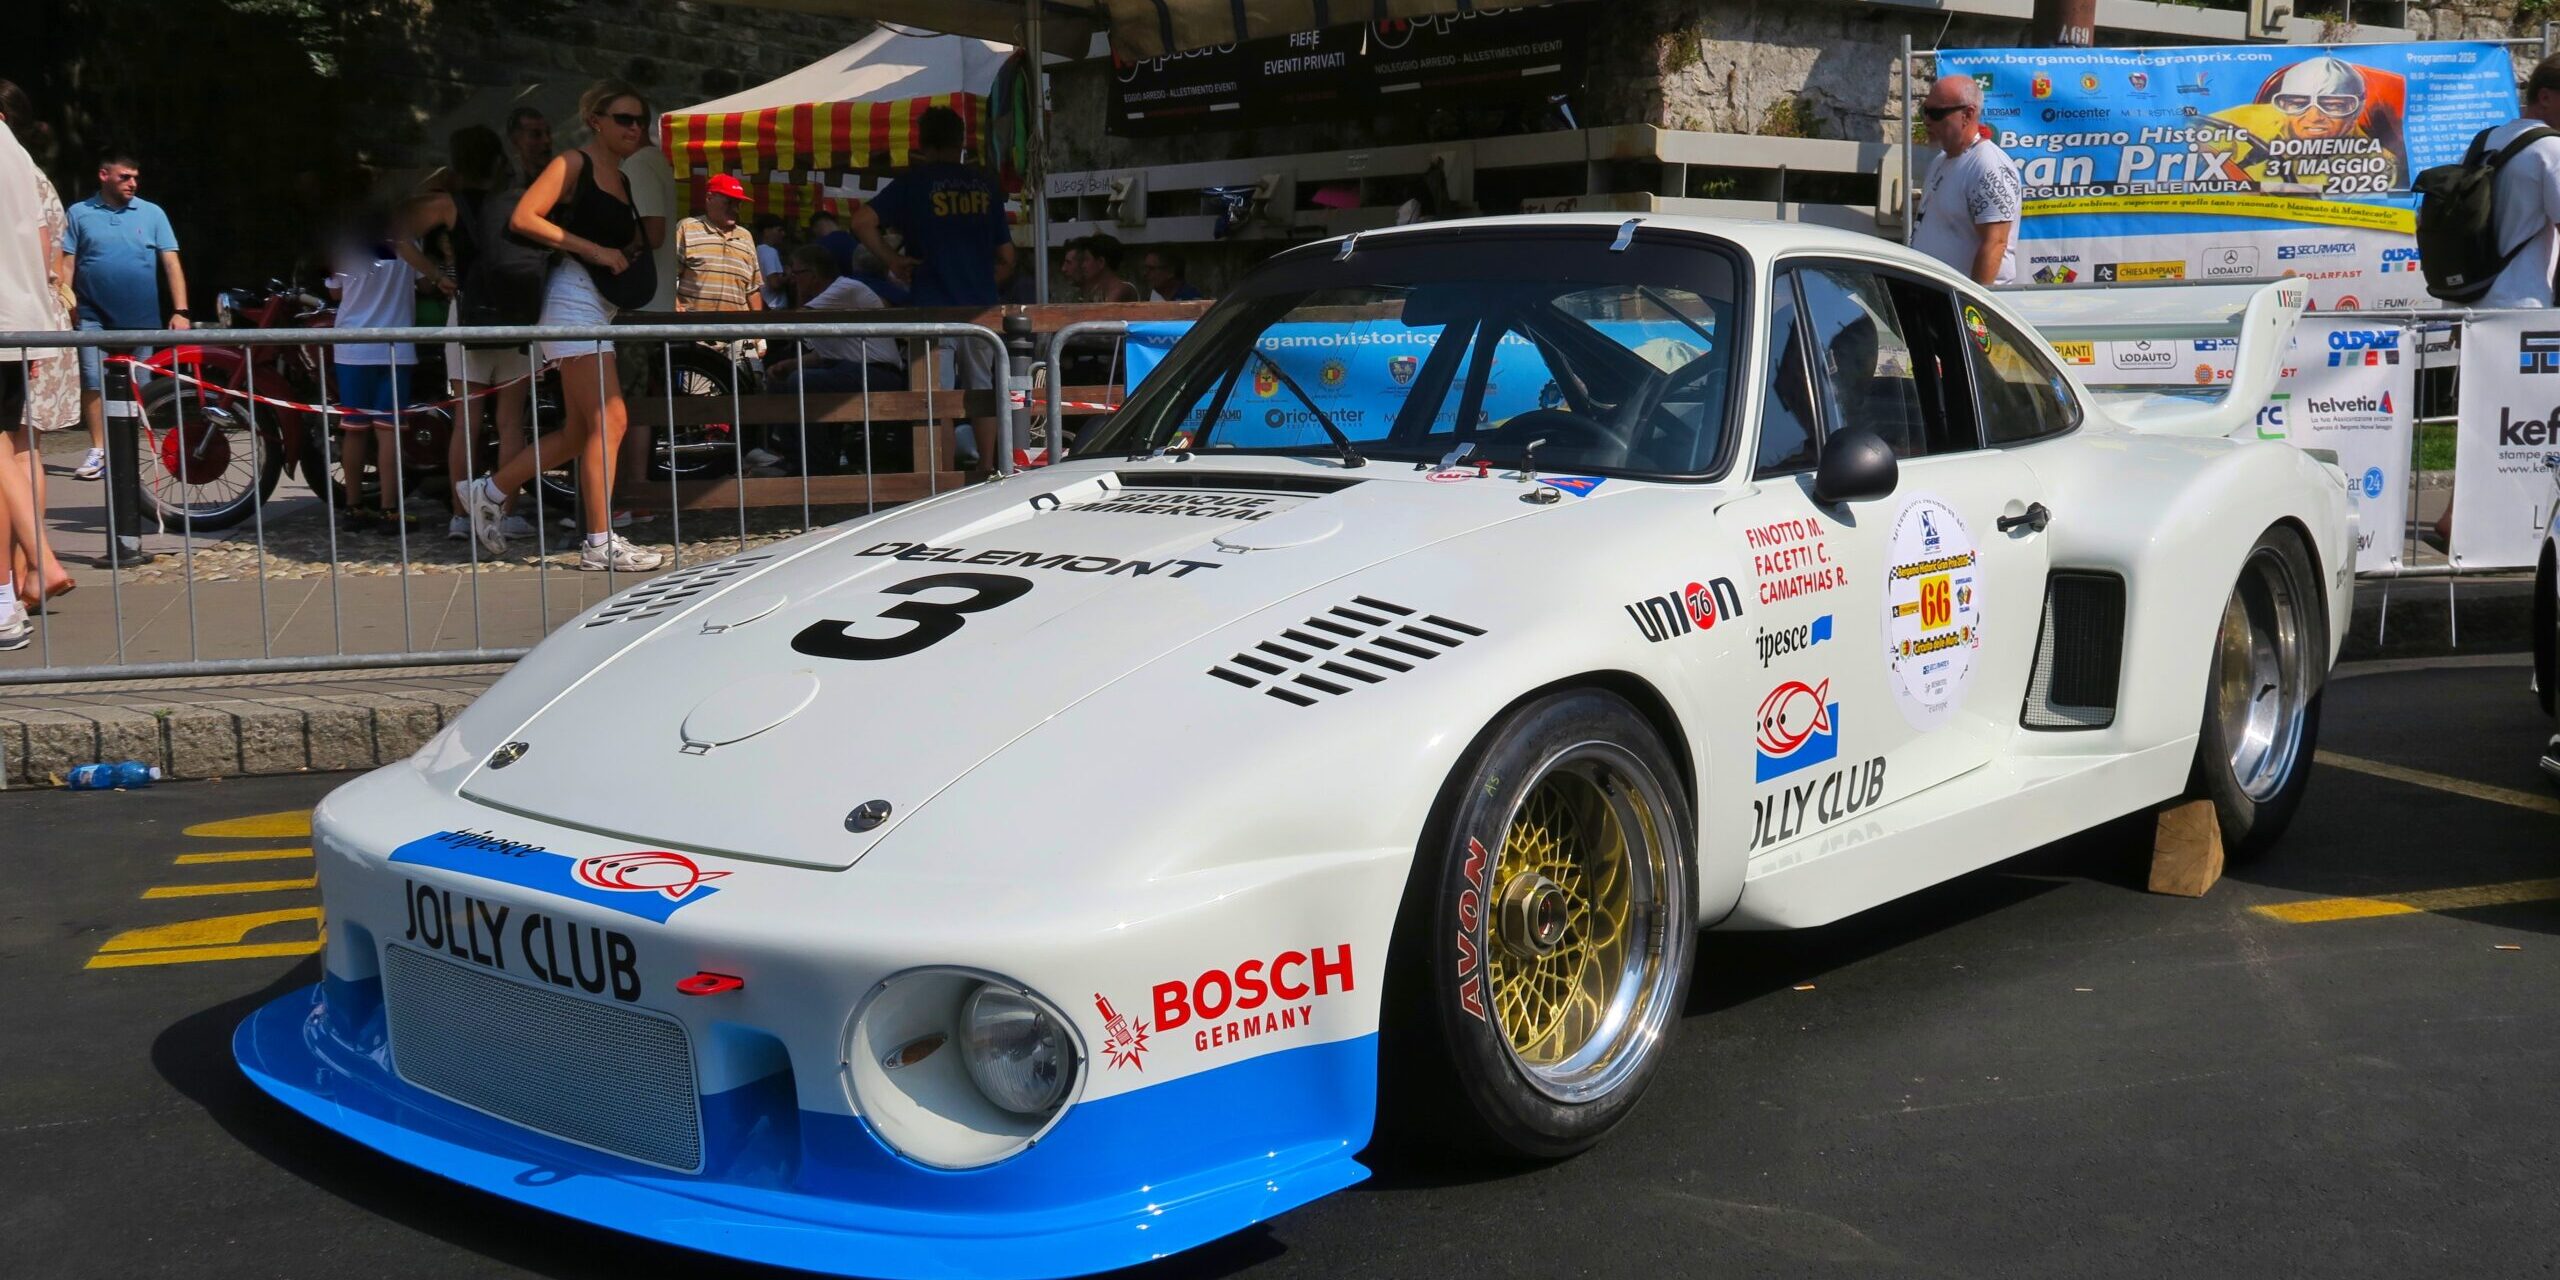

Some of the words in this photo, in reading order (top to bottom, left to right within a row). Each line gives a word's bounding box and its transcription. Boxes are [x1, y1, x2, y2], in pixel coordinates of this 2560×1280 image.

[1264, 57, 1301, 75] EVENTI
[1304, 51, 1345, 70] PRIVATI
[1375, 59, 1419, 74] NOLEGGIO
[1420, 54, 1456, 68] ARREDO
[1463, 46, 1530, 63] ALLESTIMENTO
[1532, 40, 1562, 54] EVENTI
[1952, 50, 2272, 67] www.bergamohistoricgranprix.com
[2000, 128, 2130, 153] Bergamo
[2139, 125, 2249, 144] Historic
[2269, 138, 2383, 156] DOMENICA
[2116, 144, 2236, 186] Prix
[2265, 159, 2290, 177] 31
[2298, 157, 2387, 176] MAGGIO
[2112, 182, 2183, 197] DELLE
[2188, 180, 2252, 194] MURA
[2324, 174, 2390, 194] 2026
[2030, 254, 2080, 264] SORVEGLIANZA
[2119, 267, 2148, 277] CHIESA
[2149, 265, 2184, 276] IMPIANTI
[2207, 265, 2254, 275] LODAUTO
[2119, 352, 2172, 364] LODAUTO
[2308, 394, 2377, 414] helvetia
[2499, 451, 2541, 462] stampe
[1109, 493, 1276, 509] BANQUE
[1745, 521, 1805, 549] FINOTTO
[1807, 517, 1825, 537] M.
[855, 541, 1224, 579] DELEMONT
[1755, 546, 1814, 577] FACETTI
[1817, 542, 1832, 563] C.
[1759, 571, 1834, 605] CAMATHIAS
[1836, 566, 1848, 587] R.
[790, 572, 1035, 661] 3
[1690, 590, 1712, 620] 76
[1921, 579, 1952, 627] 66
[1817, 755, 1887, 825] CLUB
[437, 827, 546, 858] tripesce
[405, 878, 510, 970] JOLLY
[521, 912, 642, 1002] CLUB
[1457, 836, 1489, 1022] AVON
[1152, 943, 1355, 1033] BOSCH
[1195, 1004, 1313, 1053] GERMANY
